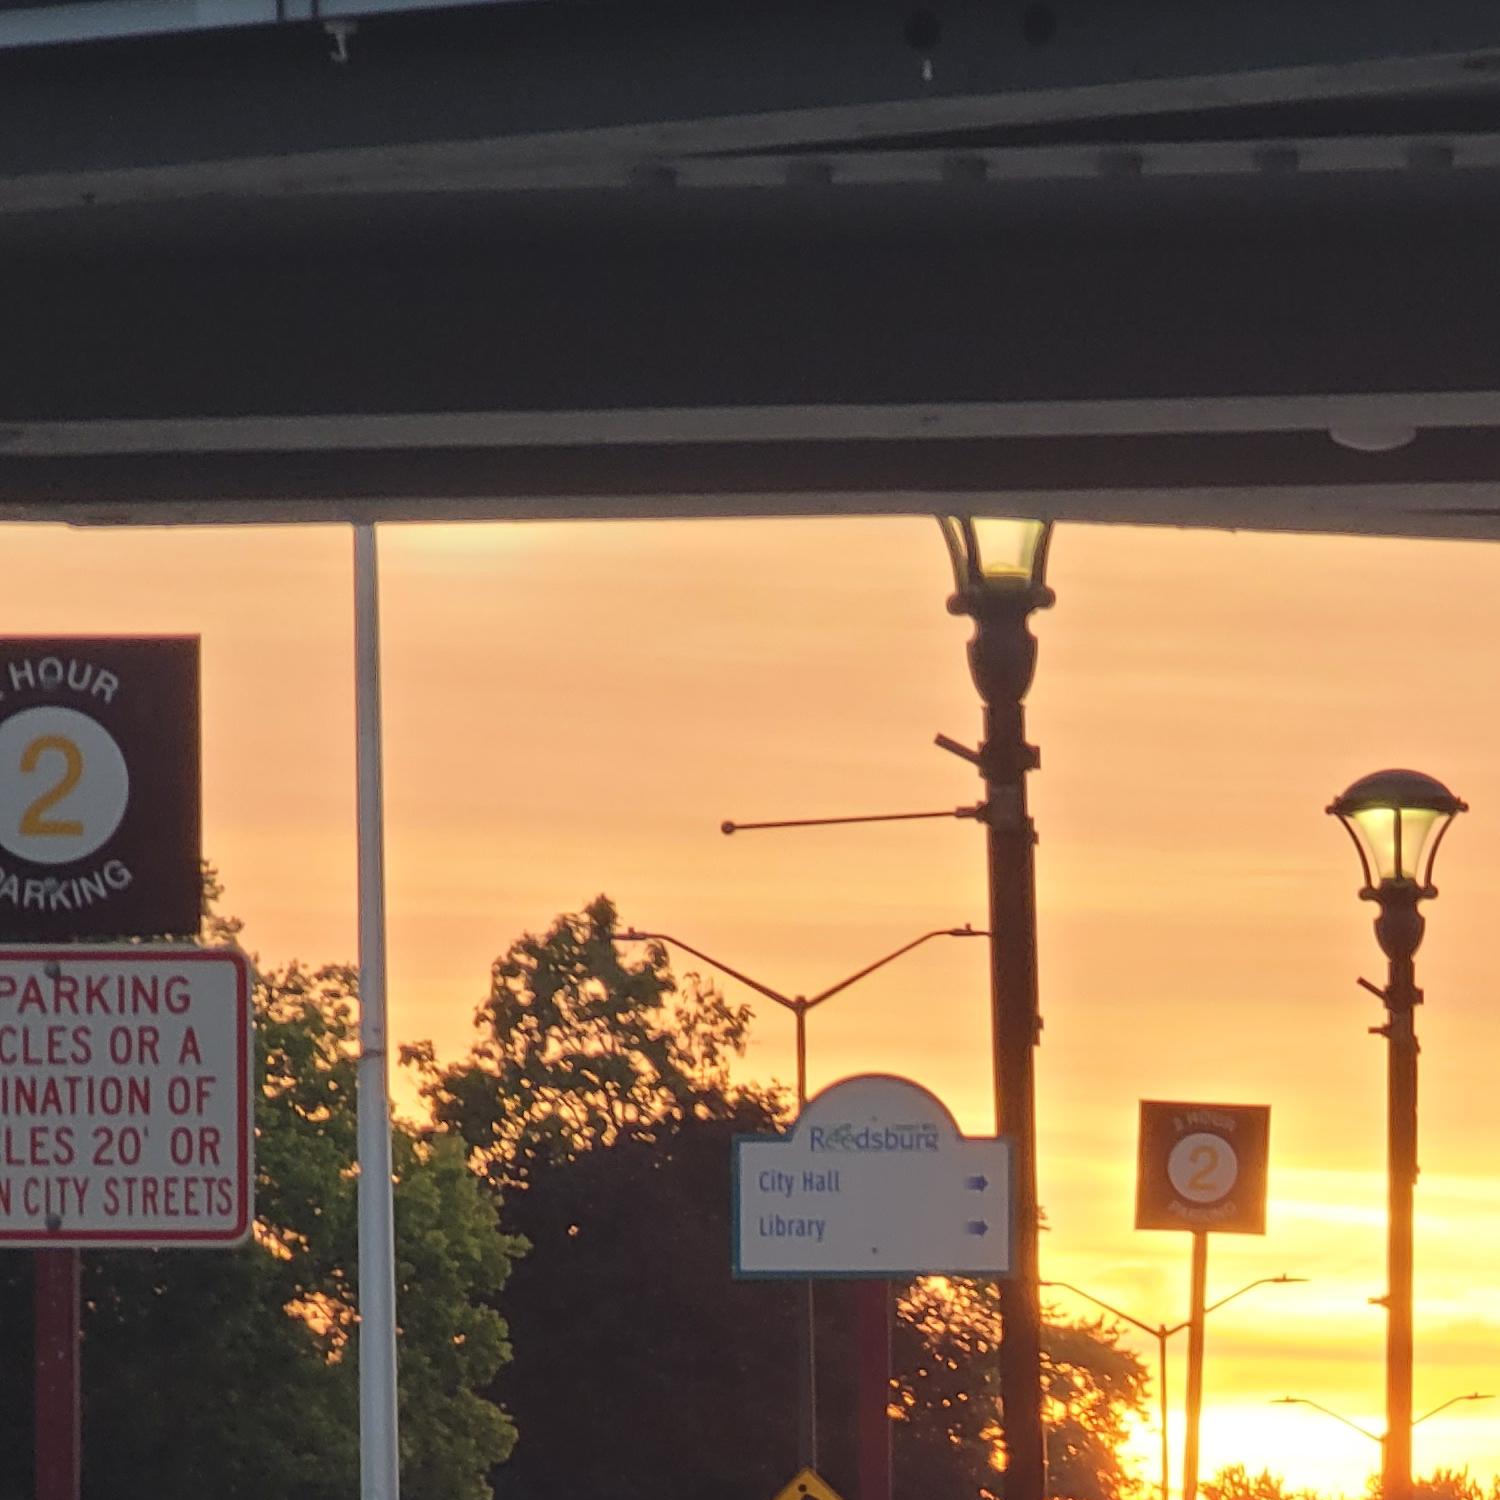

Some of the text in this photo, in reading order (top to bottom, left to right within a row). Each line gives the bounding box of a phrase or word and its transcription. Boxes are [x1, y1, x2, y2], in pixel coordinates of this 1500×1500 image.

[8, 656, 119, 704] HOUR
[19, 734, 83, 838] 2
[0, 859, 133, 911] ARKING
[0, 975, 191, 1015] PARKING
[109, 1025, 160, 1066] OR
[178, 1026, 201, 1066] A
[168, 1076, 216, 1116] OF
[170, 1126, 221, 1166] OR
[759, 1170, 840, 1198] City Hall
[1187, 1145, 1219, 1190] 2
[23, 1176, 89, 1217] CITY
[103, 1176, 233, 1217] STREETS
[759, 1214, 826, 1242] Library
